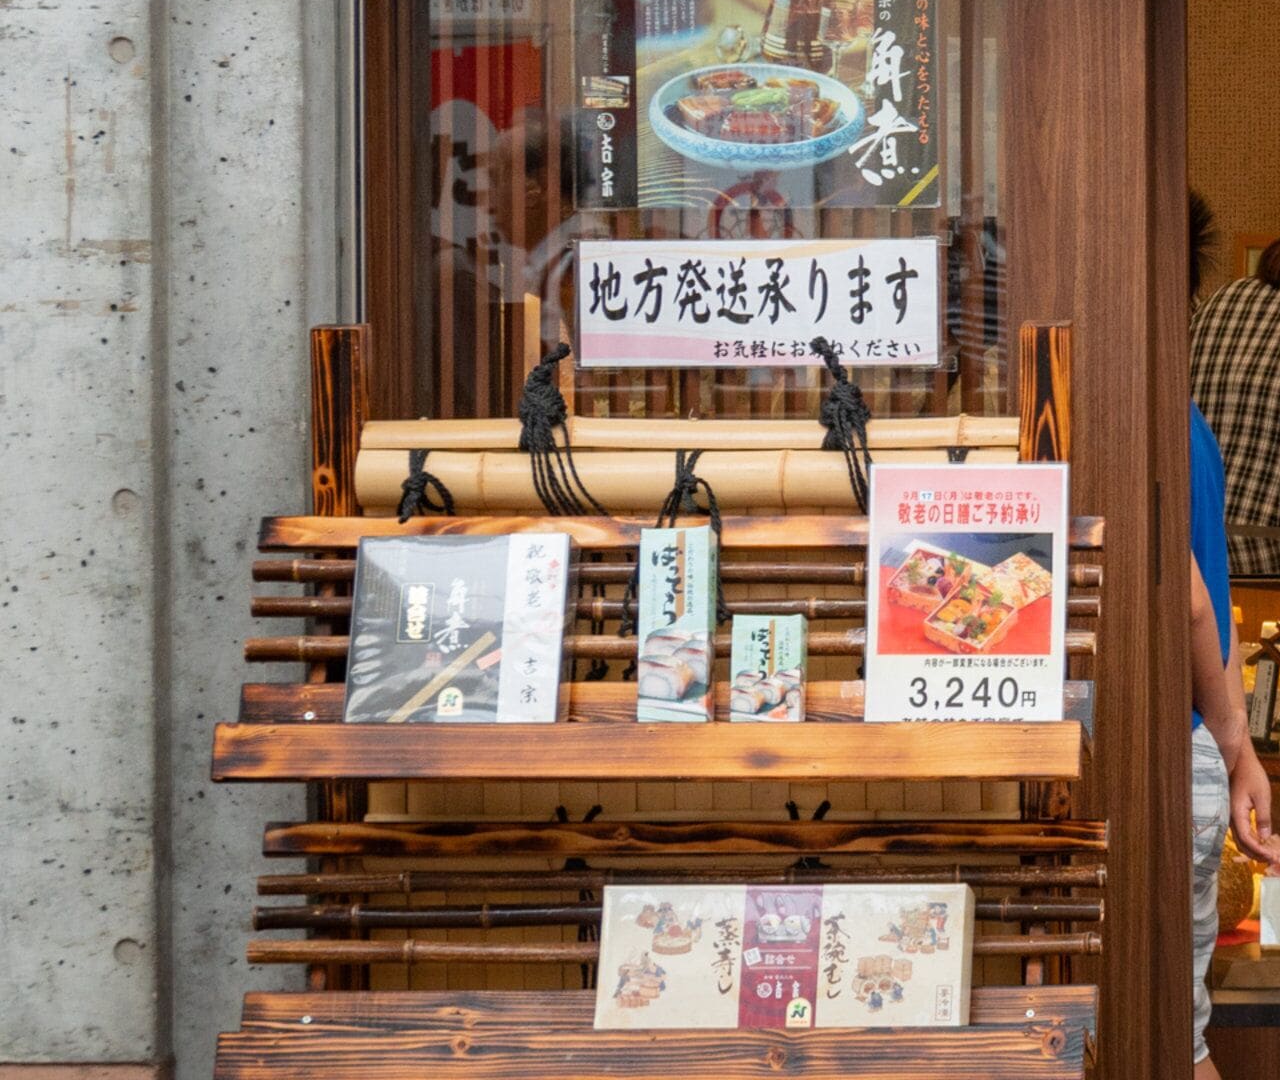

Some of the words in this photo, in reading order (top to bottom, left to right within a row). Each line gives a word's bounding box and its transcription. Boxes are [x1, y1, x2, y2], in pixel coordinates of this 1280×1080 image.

[848, 26, 919, 187] 角煮
[589, 255, 919, 325] 地方発送承ります
[897, 502, 1041, 525] 敬老の日膳ご予約承り
[908, 676, 1037, 709] 3,240円
